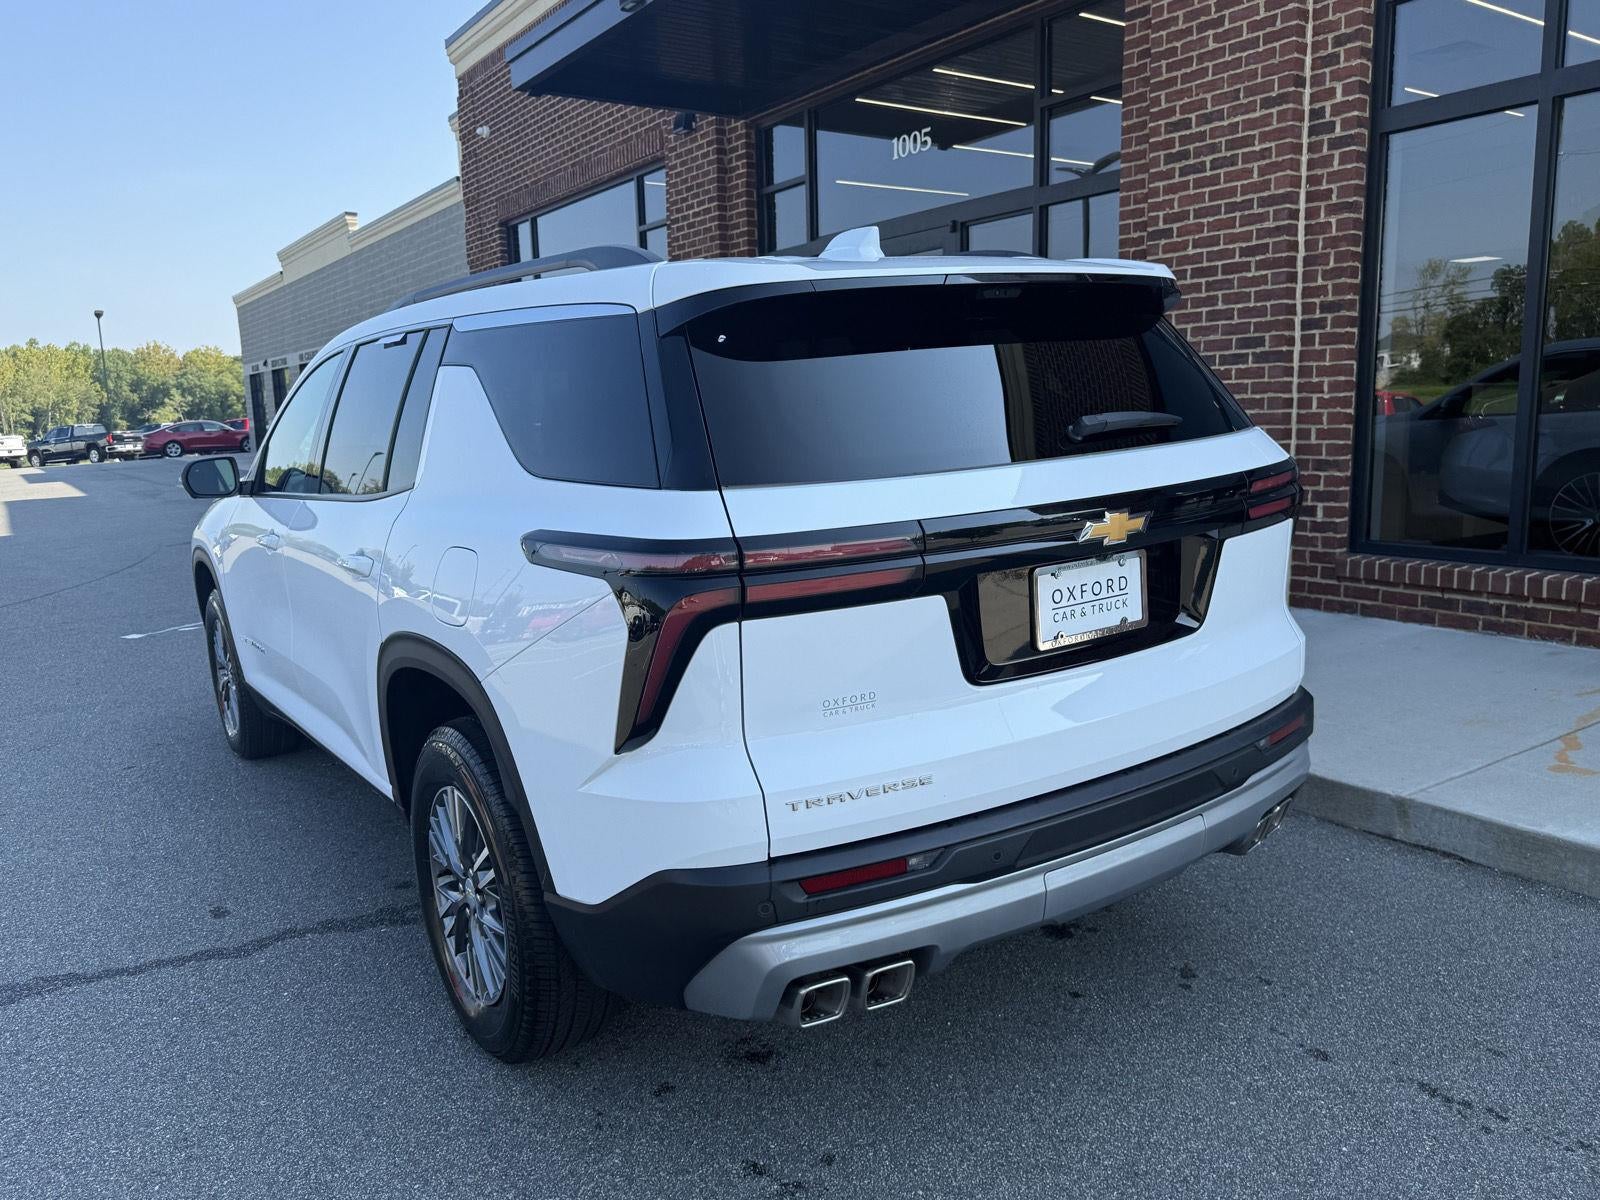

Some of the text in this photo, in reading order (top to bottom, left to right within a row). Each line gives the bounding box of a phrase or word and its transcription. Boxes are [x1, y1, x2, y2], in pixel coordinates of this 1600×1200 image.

[892, 126, 932, 160] 1005
[1052, 576, 1128, 604] OXFORD
[1053, 598, 1129, 623] CAR & TRUCK
[822, 691, 876, 708] OXFORD
[823, 710, 840, 718] CAR
[850, 703, 876, 713] TRUCK
[785, 774, 934, 812] TRAVERSE
